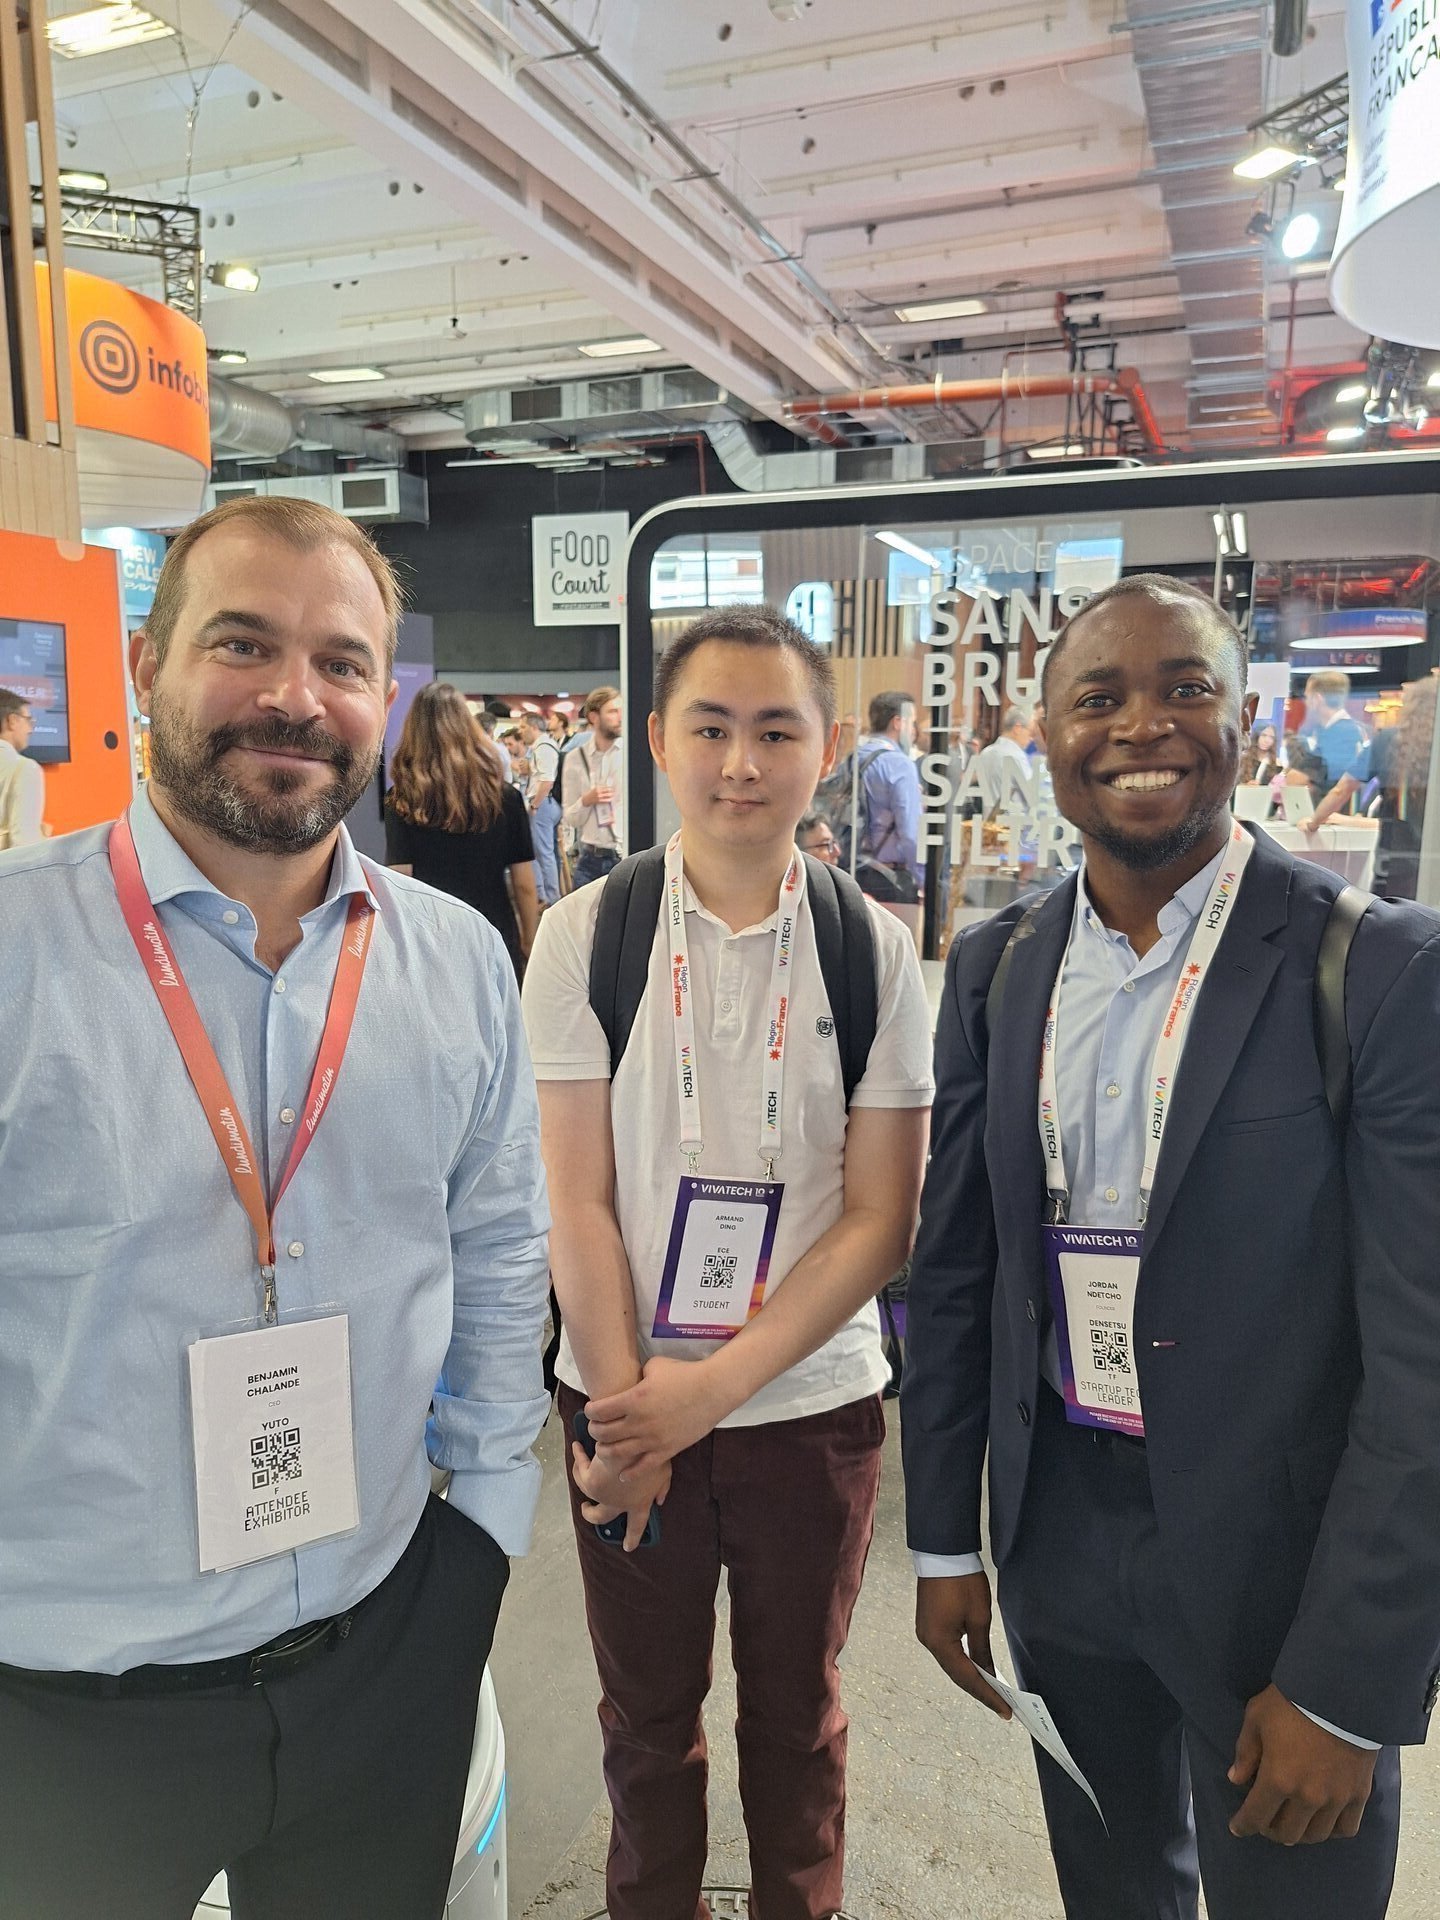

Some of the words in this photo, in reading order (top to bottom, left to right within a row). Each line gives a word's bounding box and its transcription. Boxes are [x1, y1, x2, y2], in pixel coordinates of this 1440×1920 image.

[1366, 34, 1440, 128] FRANÇA
[148, 346, 207, 413] infob
[551, 530, 609, 569] FOOD
[552, 569, 611, 596] Court
[925, 586, 1092, 647] SANS
[671, 876, 681, 926] VIVATECH
[1206, 872, 1237, 930] VIVATECH
[143, 921, 180, 987] lundimatin
[779, 917, 793, 967] VIVATECH
[680, 966, 688, 994] Région
[1181, 978, 1199, 1011] Région
[767, 1019, 777, 1047] Région
[681, 1046, 693, 1098] VIVATECH
[305, 1067, 335, 1134] lundimatin
[1152, 1076, 1167, 1140] VIVATECH
[219, 1106, 253, 1175] lundimatin
[1042, 1100, 1057, 1159] VIVATECH
[701, 1184, 753, 1197] VIVATECH
[715, 1215, 745, 1223] ARMAND
[720, 1223, 737, 1231] DING
[1062, 1233, 1122, 1246] VIVATECH
[1087, 1291, 1122, 1300] NDETCHO
[1088, 1281, 1118, 1290] JORDAN
[693, 1300, 731, 1310] STUDENT
[1089, 1319, 1126, 1330] DENSETSU
[246, 1378, 301, 1398] CHALANDE
[247, 1366, 299, 1385] BENJAMIN
[1081, 1381, 1122, 1395] STARTUP
[268, 1400, 281, 1408] CEO
[1097, 1392, 1134, 1406] LEADER
[261, 1417, 290, 1431] YUTO
[246, 1490, 309, 1518] ATTENDEE
[274, 1486, 280, 1495] F
[244, 1502, 311, 1532] EXHIBITOR
